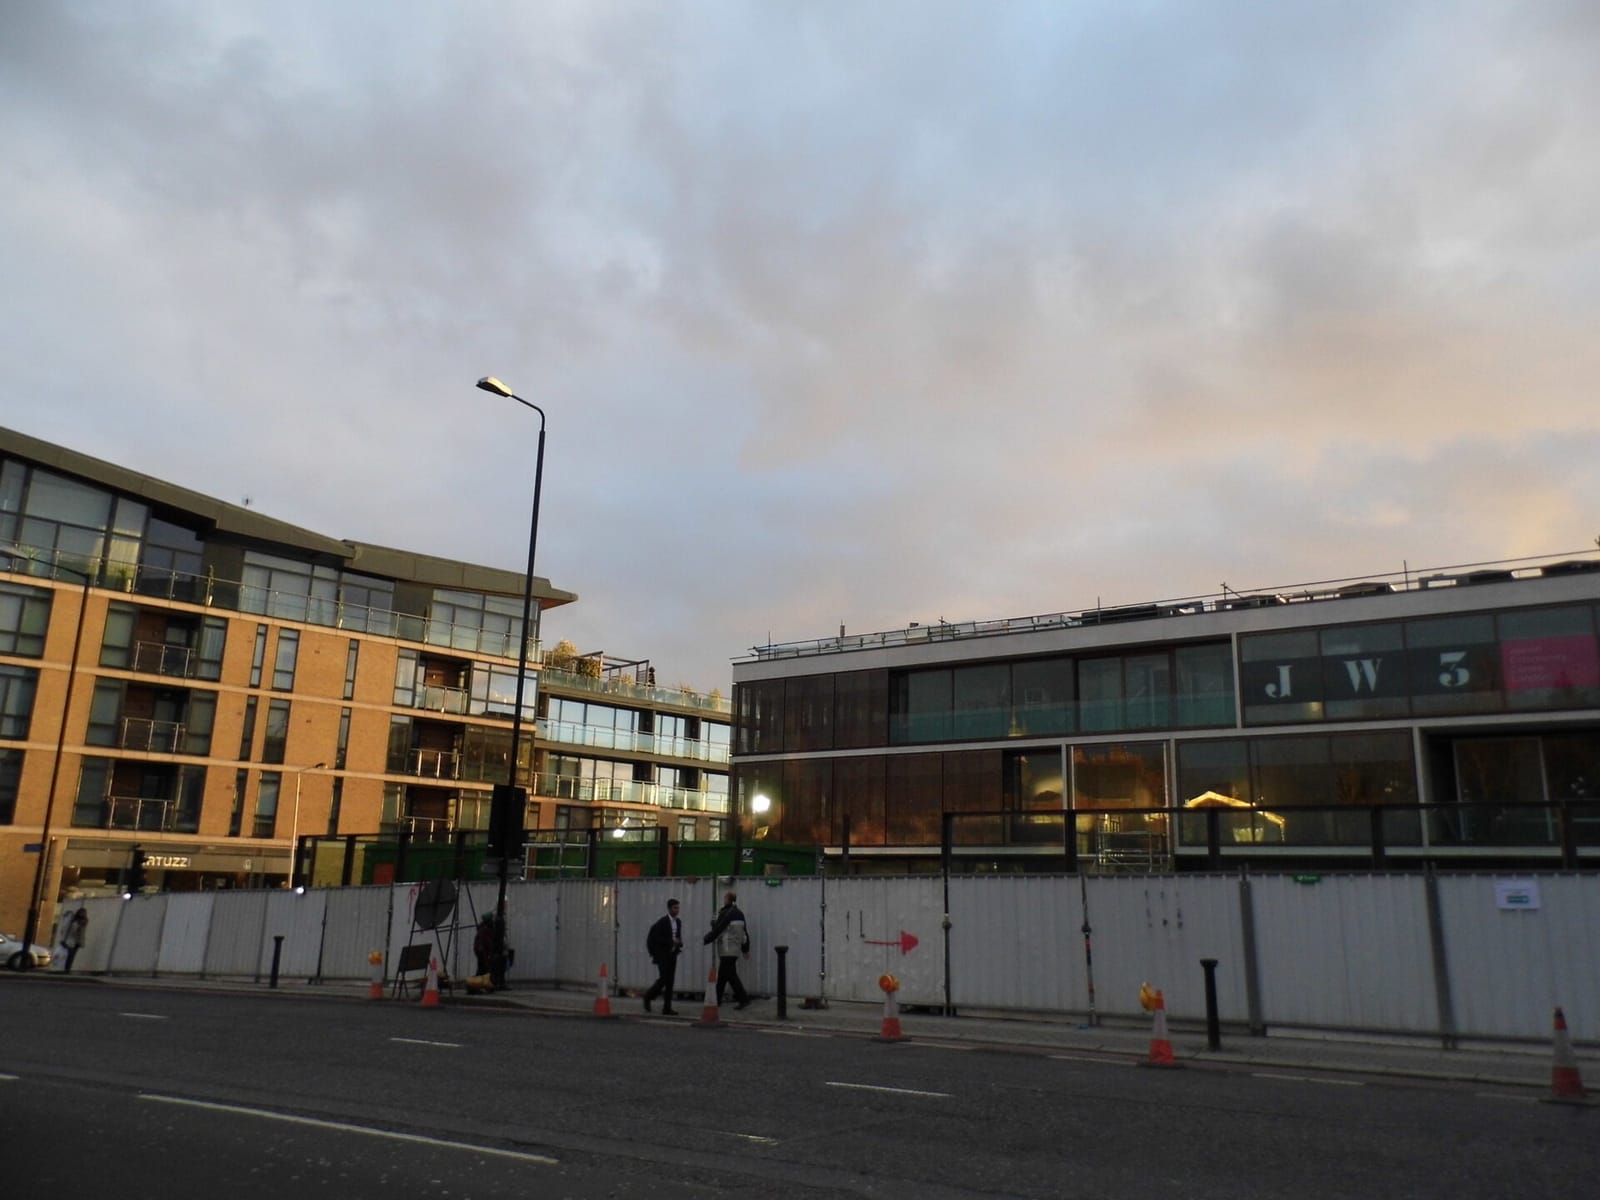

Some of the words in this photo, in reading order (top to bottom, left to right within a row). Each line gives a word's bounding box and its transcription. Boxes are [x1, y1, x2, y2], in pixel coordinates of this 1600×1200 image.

[1265, 664, 1293, 697] J
[1344, 658, 1383, 692] W
[1439, 651, 1470, 687] 3
